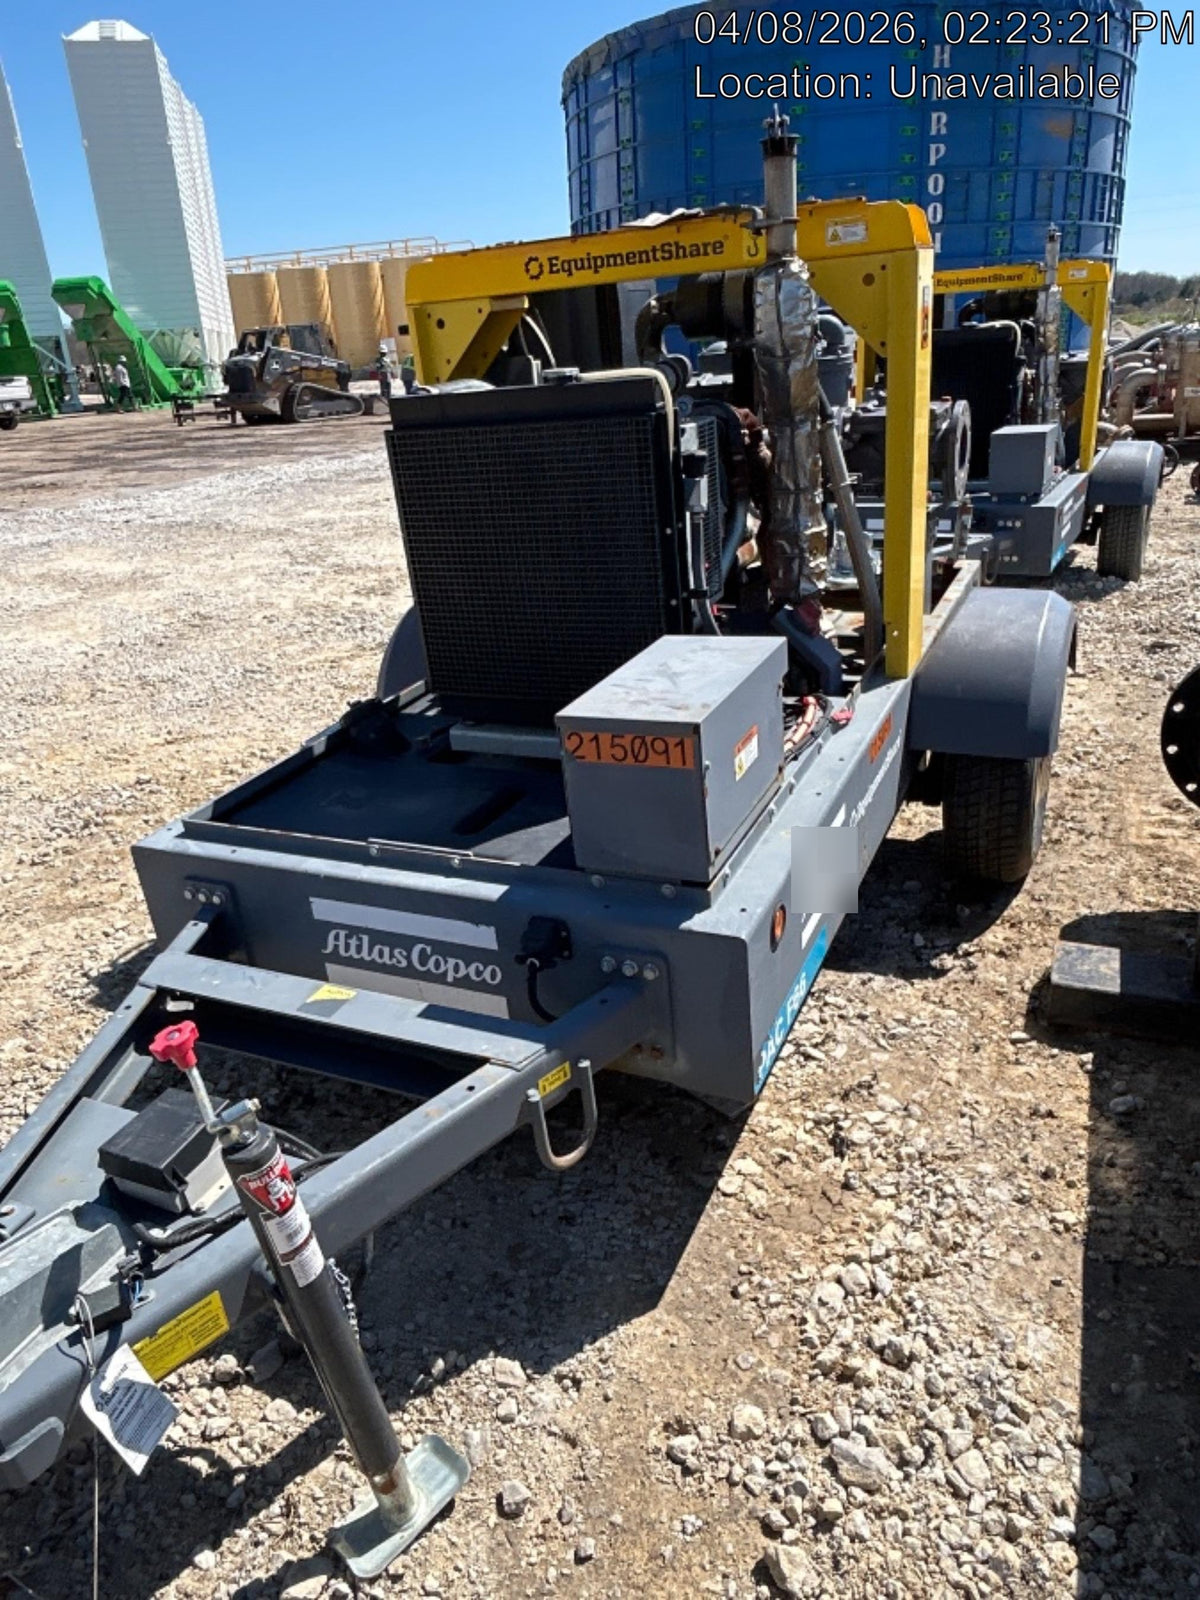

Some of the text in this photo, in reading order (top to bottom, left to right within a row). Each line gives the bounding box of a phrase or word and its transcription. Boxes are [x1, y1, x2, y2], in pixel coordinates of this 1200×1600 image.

[547, 238, 725, 277] EquipmentShare
[936, 272, 1024, 288] EquipmentShare
[566, 731, 687, 767] 215091
[320, 928, 503, 985] Atlas Copco
